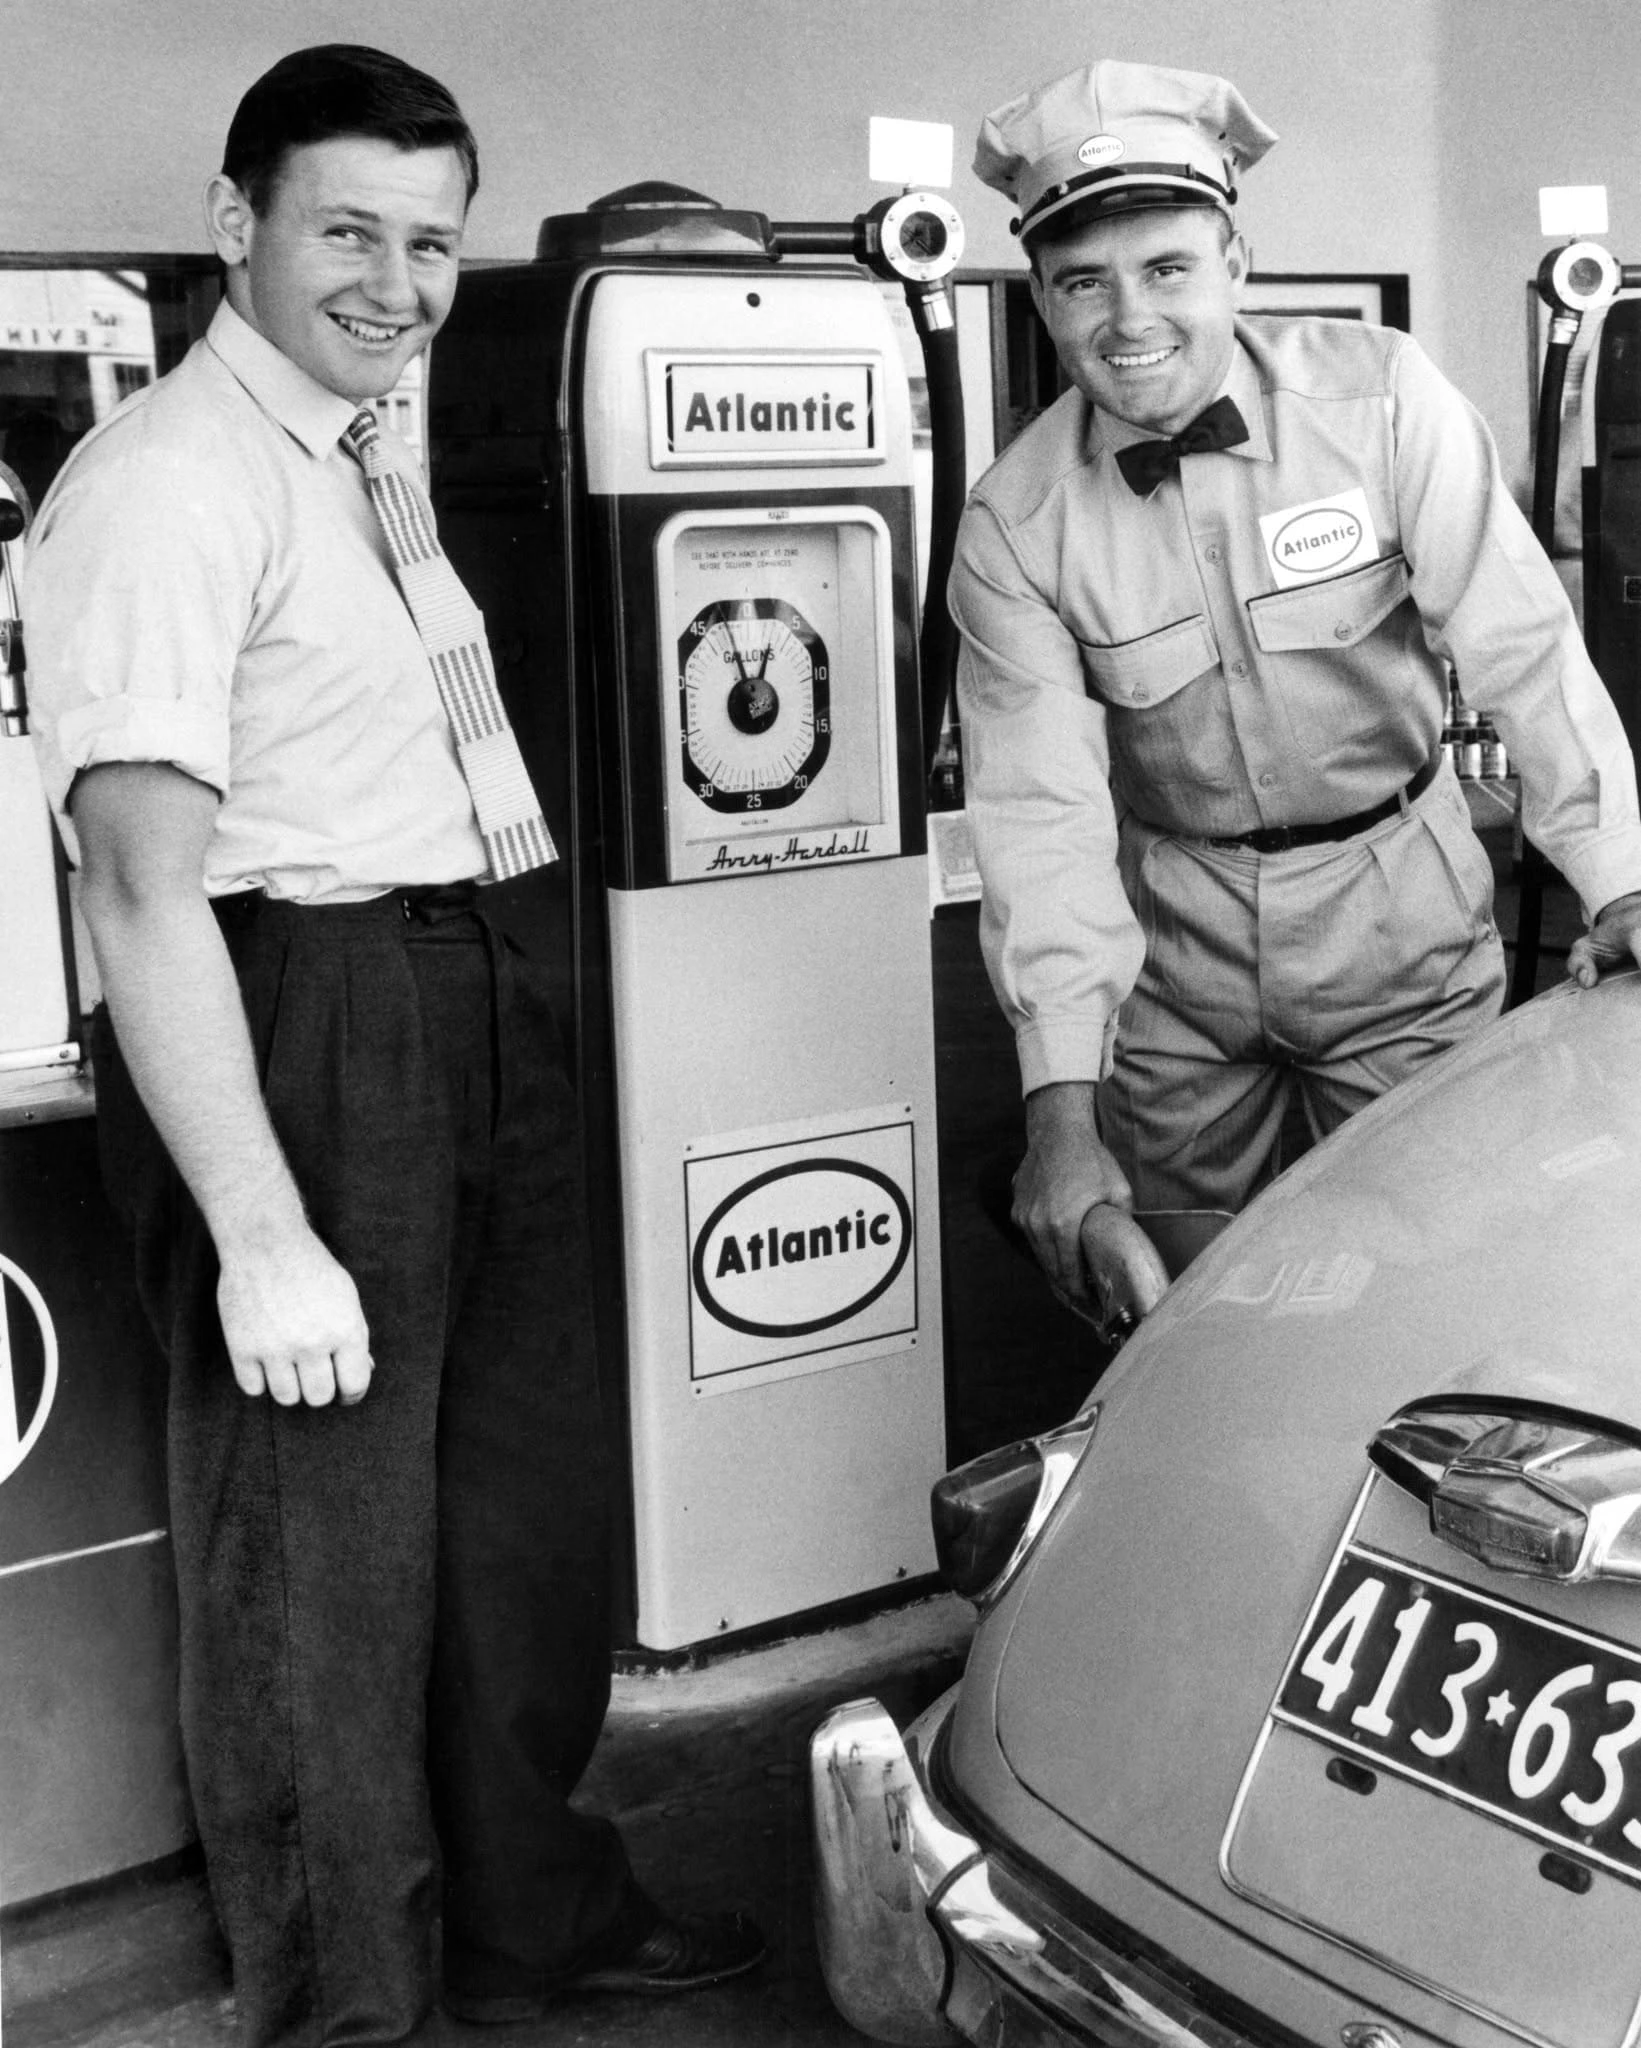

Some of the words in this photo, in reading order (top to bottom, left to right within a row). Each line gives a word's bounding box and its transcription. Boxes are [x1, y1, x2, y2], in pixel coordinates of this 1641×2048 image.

[1081, 144, 1121, 158] Atlantic
[685, 392, 856, 432] Atlantic
[1284, 525, 1356, 557] Atlantic
[743, 602, 751, 617] 0
[689, 621, 706, 636] 45
[791, 615, 800, 630] 5
[723, 650, 775, 664] GALLONS
[814, 666, 827, 681] 10
[816, 718, 829, 733] 15
[794, 775, 808, 789] 20
[699, 784, 713, 798] 30
[747, 794, 762, 808] 25
[706, 830, 870, 871] Avery-Hardoll
[715, 1209, 892, 1279] Atlantic
